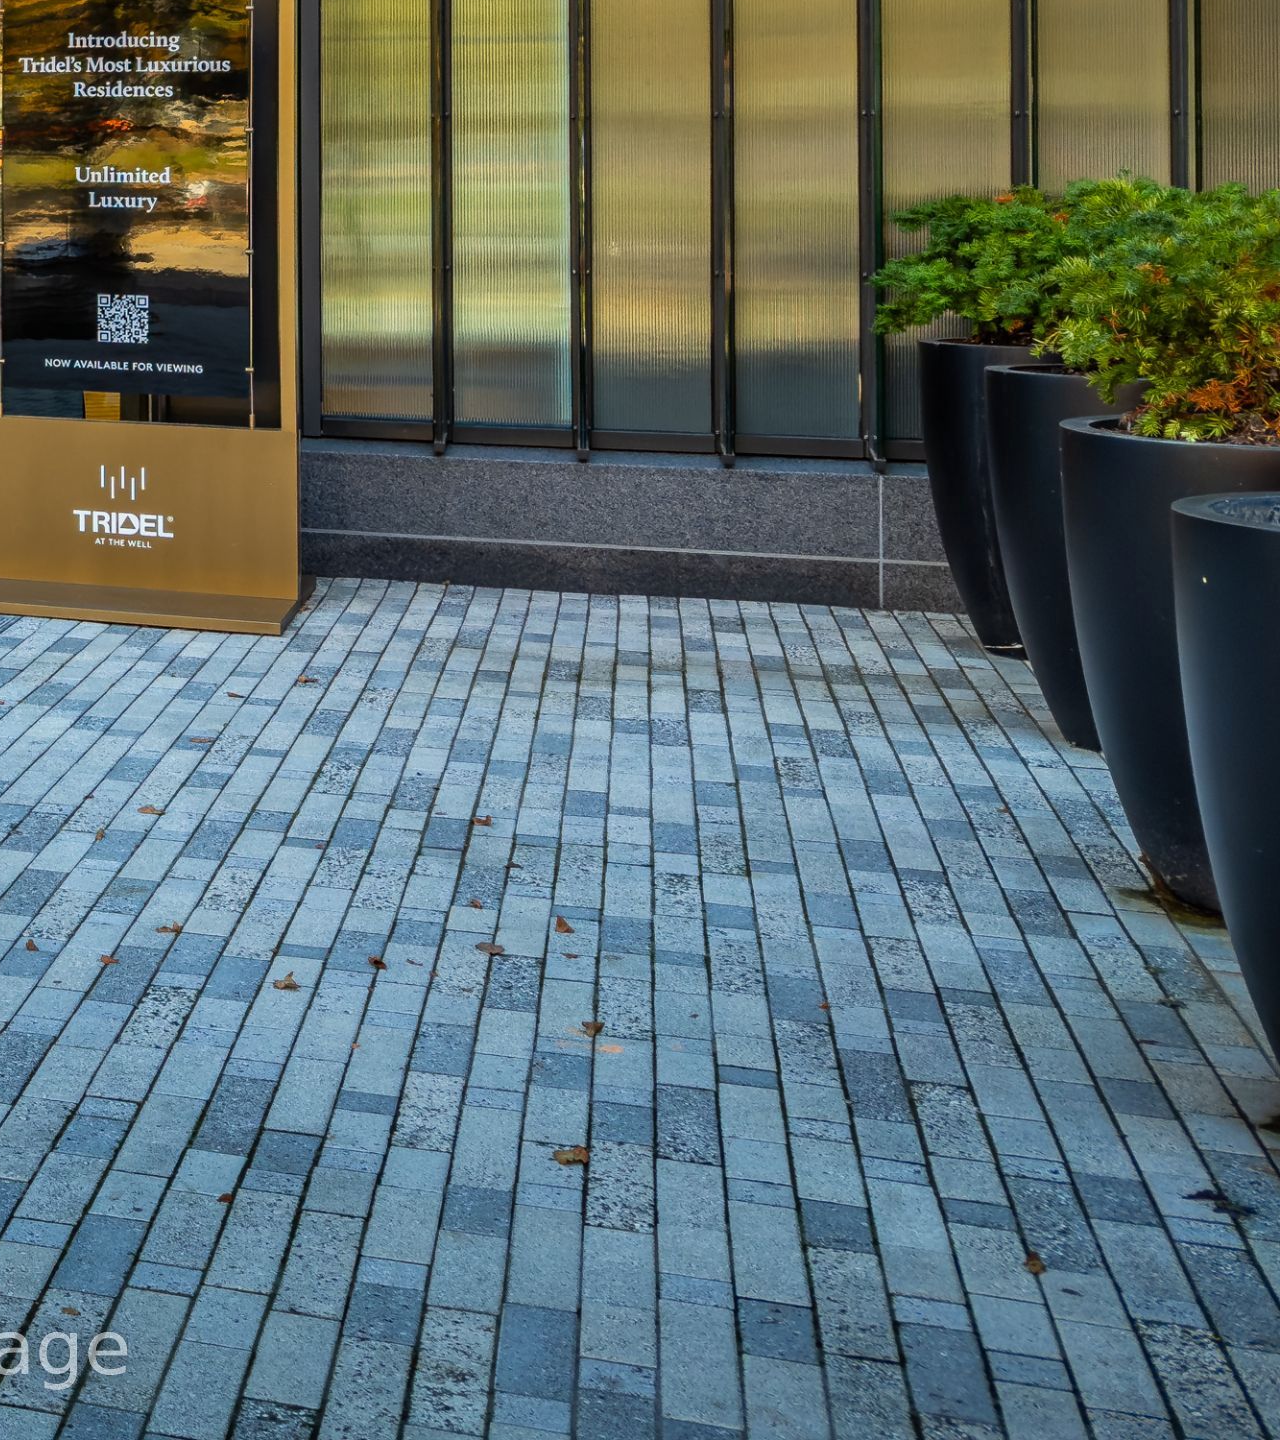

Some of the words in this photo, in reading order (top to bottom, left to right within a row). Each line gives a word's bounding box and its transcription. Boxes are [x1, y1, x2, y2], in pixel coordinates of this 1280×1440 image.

[67, 30, 181, 52] Introducing
[18, 55, 82, 74] Tridel's
[85, 56, 132, 74] Most
[135, 56, 232, 74] Luxurious
[73, 80, 174, 98] Residences
[74, 165, 172, 184] Unlimited
[88, 191, 158, 214] Luxury
[44, 358, 71, 368] NOW
[73, 359, 129, 371] AVAILABLE
[132, 361, 153, 372] FOR
[156, 363, 204, 374] VIEWING
[94, 537, 106, 545] AT
[108, 538, 126, 547] THE
[127, 539, 153, 549] WELL
